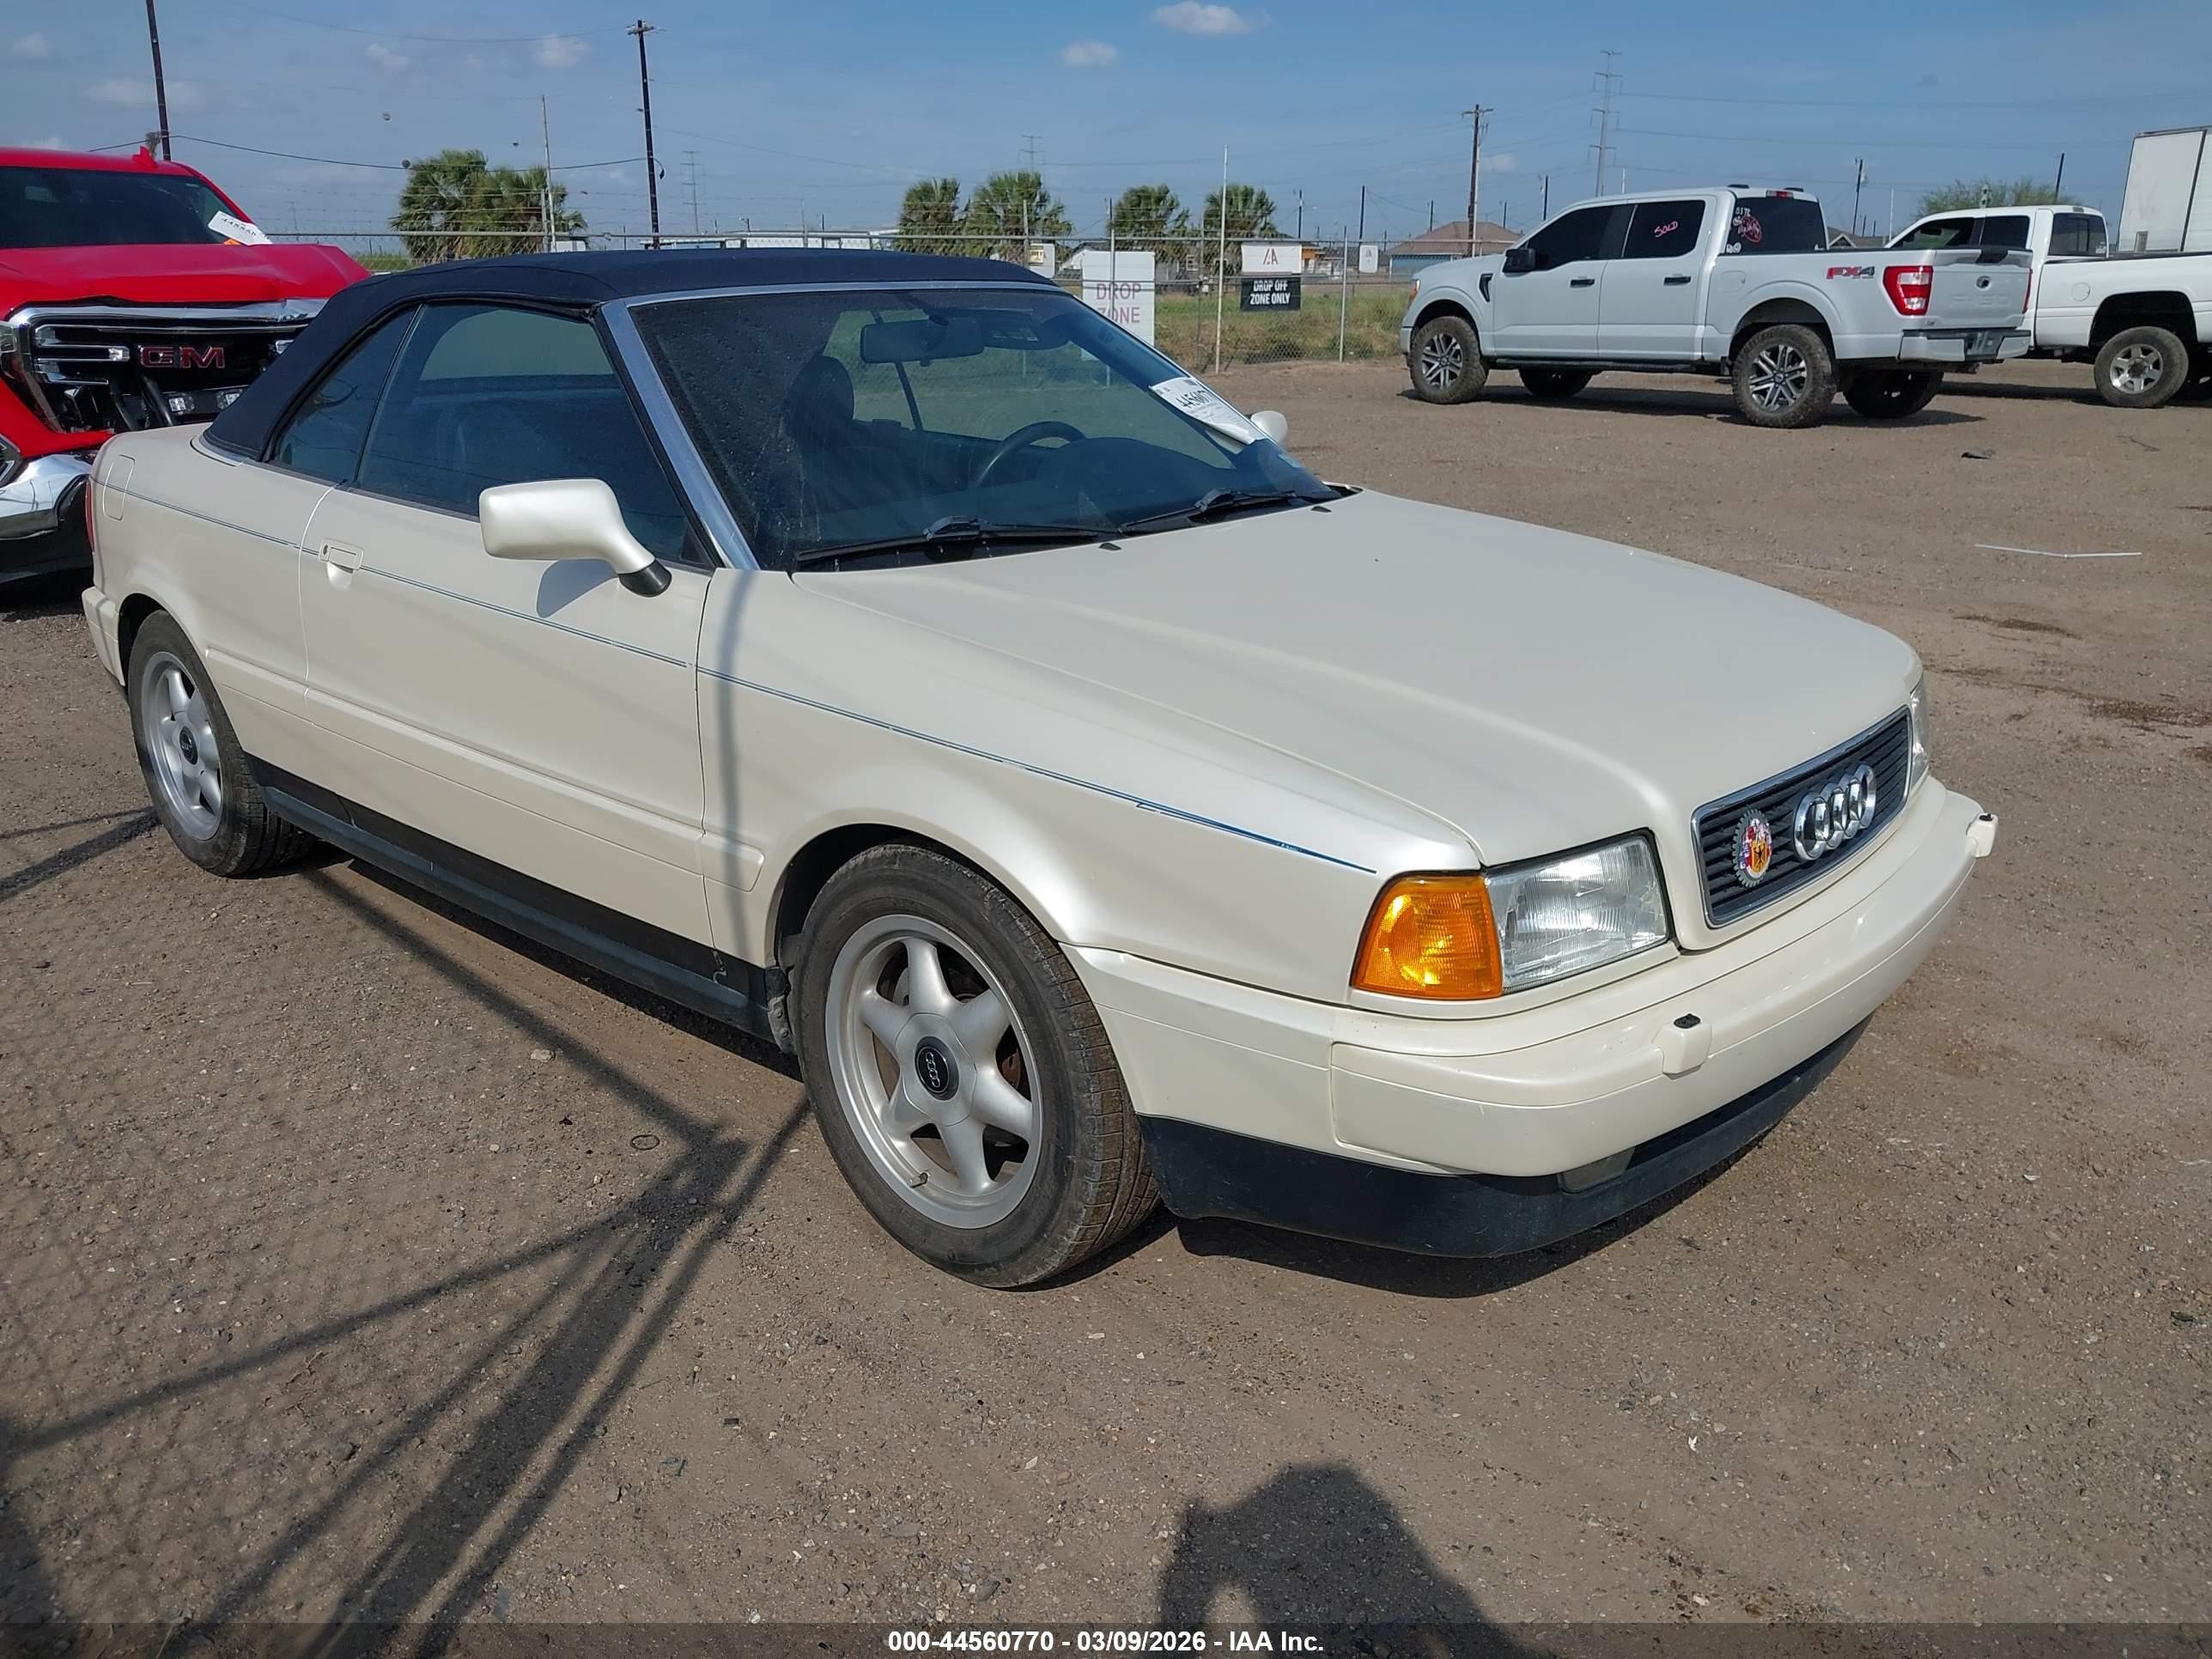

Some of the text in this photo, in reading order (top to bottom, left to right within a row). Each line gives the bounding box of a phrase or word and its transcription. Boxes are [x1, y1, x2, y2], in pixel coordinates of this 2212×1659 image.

[1654, 220, 1679, 238] SOLD
[1826, 265, 1875, 279] FX4
[1097, 283, 1141, 300] DROP
[1253, 279, 1288, 292] DROP OFF
[1249, 292, 1291, 305] ZONE ONLY
